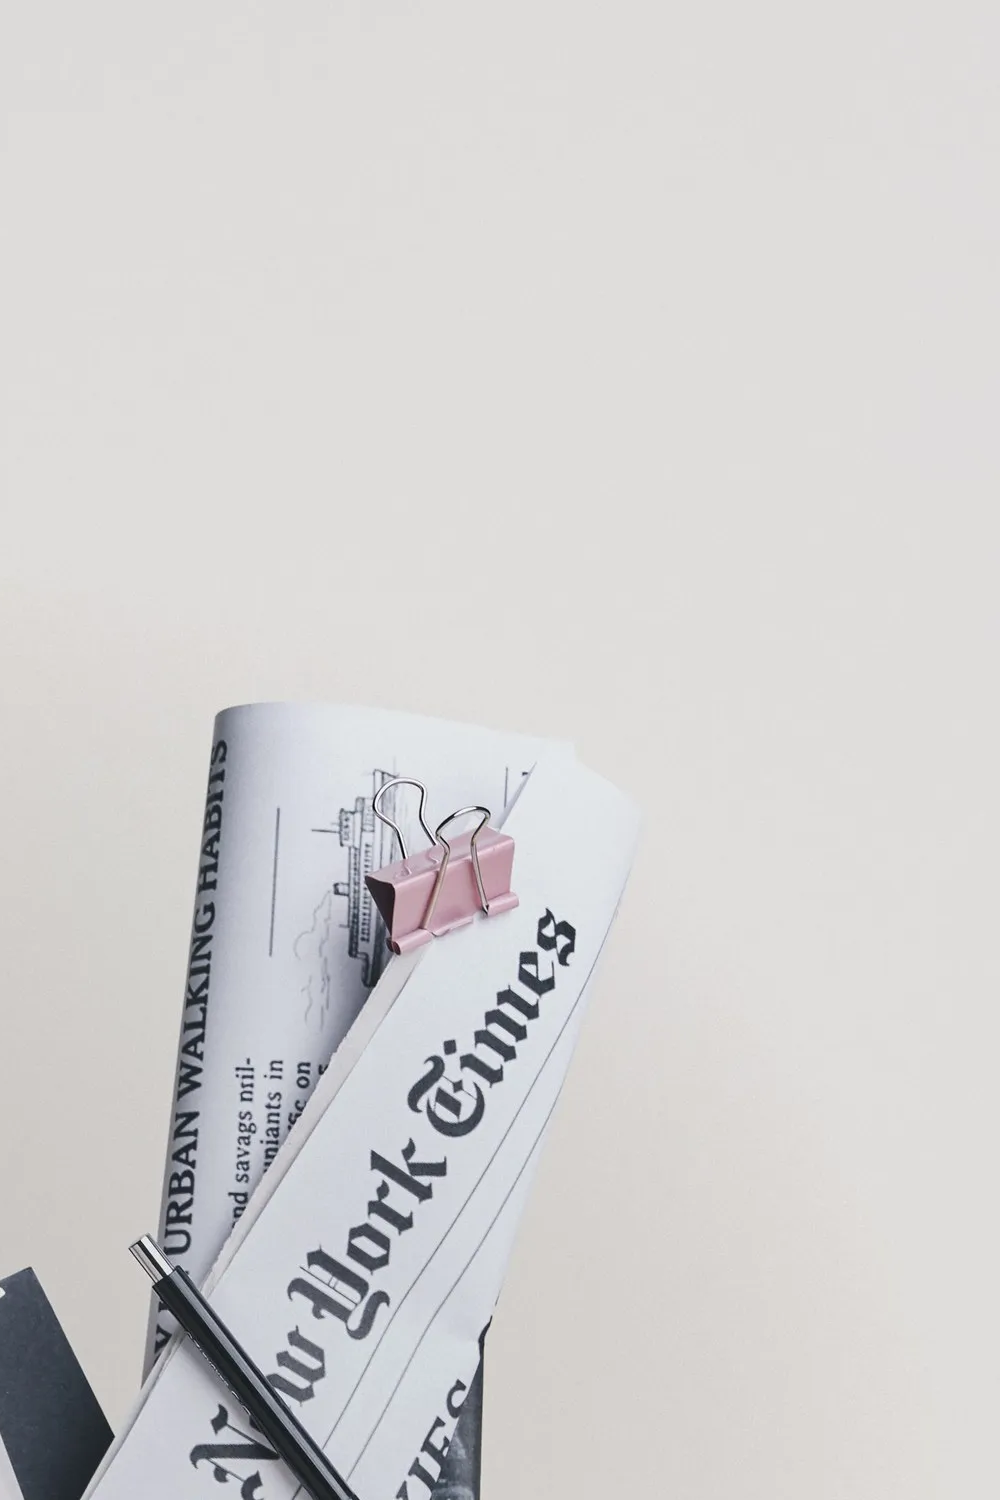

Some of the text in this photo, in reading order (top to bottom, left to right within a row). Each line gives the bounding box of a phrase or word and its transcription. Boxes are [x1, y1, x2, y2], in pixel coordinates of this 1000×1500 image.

[198, 739, 228, 897] HABITS
[176, 900, 216, 1102] WALKING
[263, 1059, 284, 1080] in
[295, 1061, 312, 1089] on
[163, 1110, 201, 1257] URBAN
[287, 1137, 447, 1341] York
[407, 907, 577, 1138] Times
